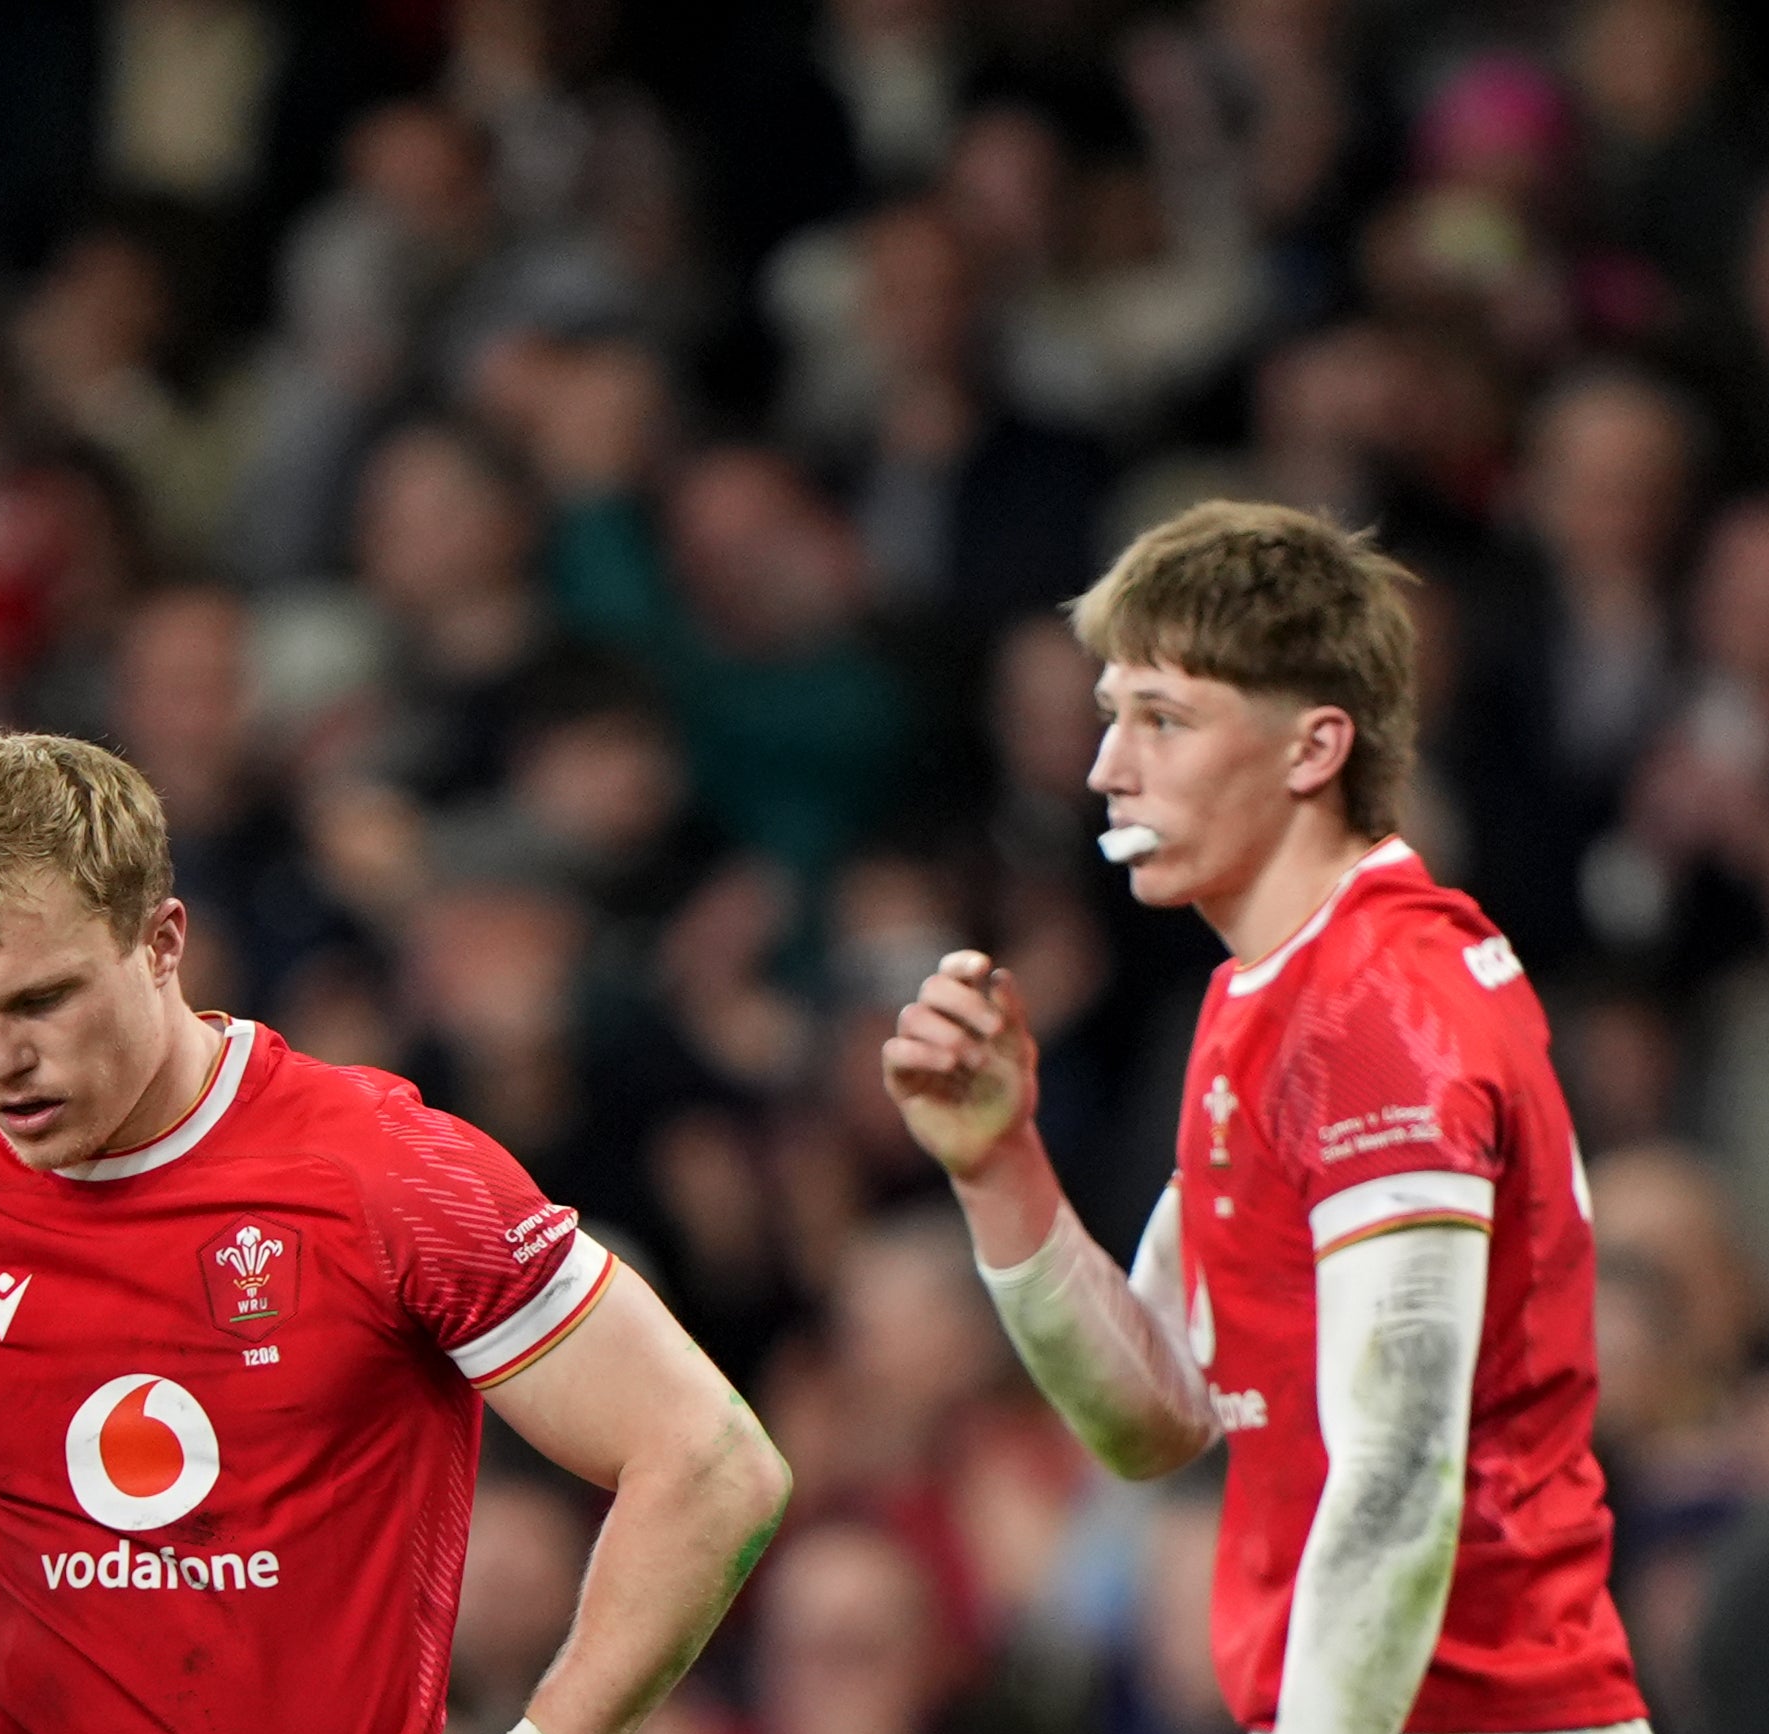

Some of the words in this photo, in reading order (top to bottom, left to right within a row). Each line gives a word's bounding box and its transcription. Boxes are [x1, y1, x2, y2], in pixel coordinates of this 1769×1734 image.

[504, 1213, 544, 1243] Cymru
[512, 1234, 548, 1265] 15fed
[237, 1297, 269, 1314] WRU
[242, 1345, 280, 1367] 1208
[40, 1538, 280, 1592] vodafone
